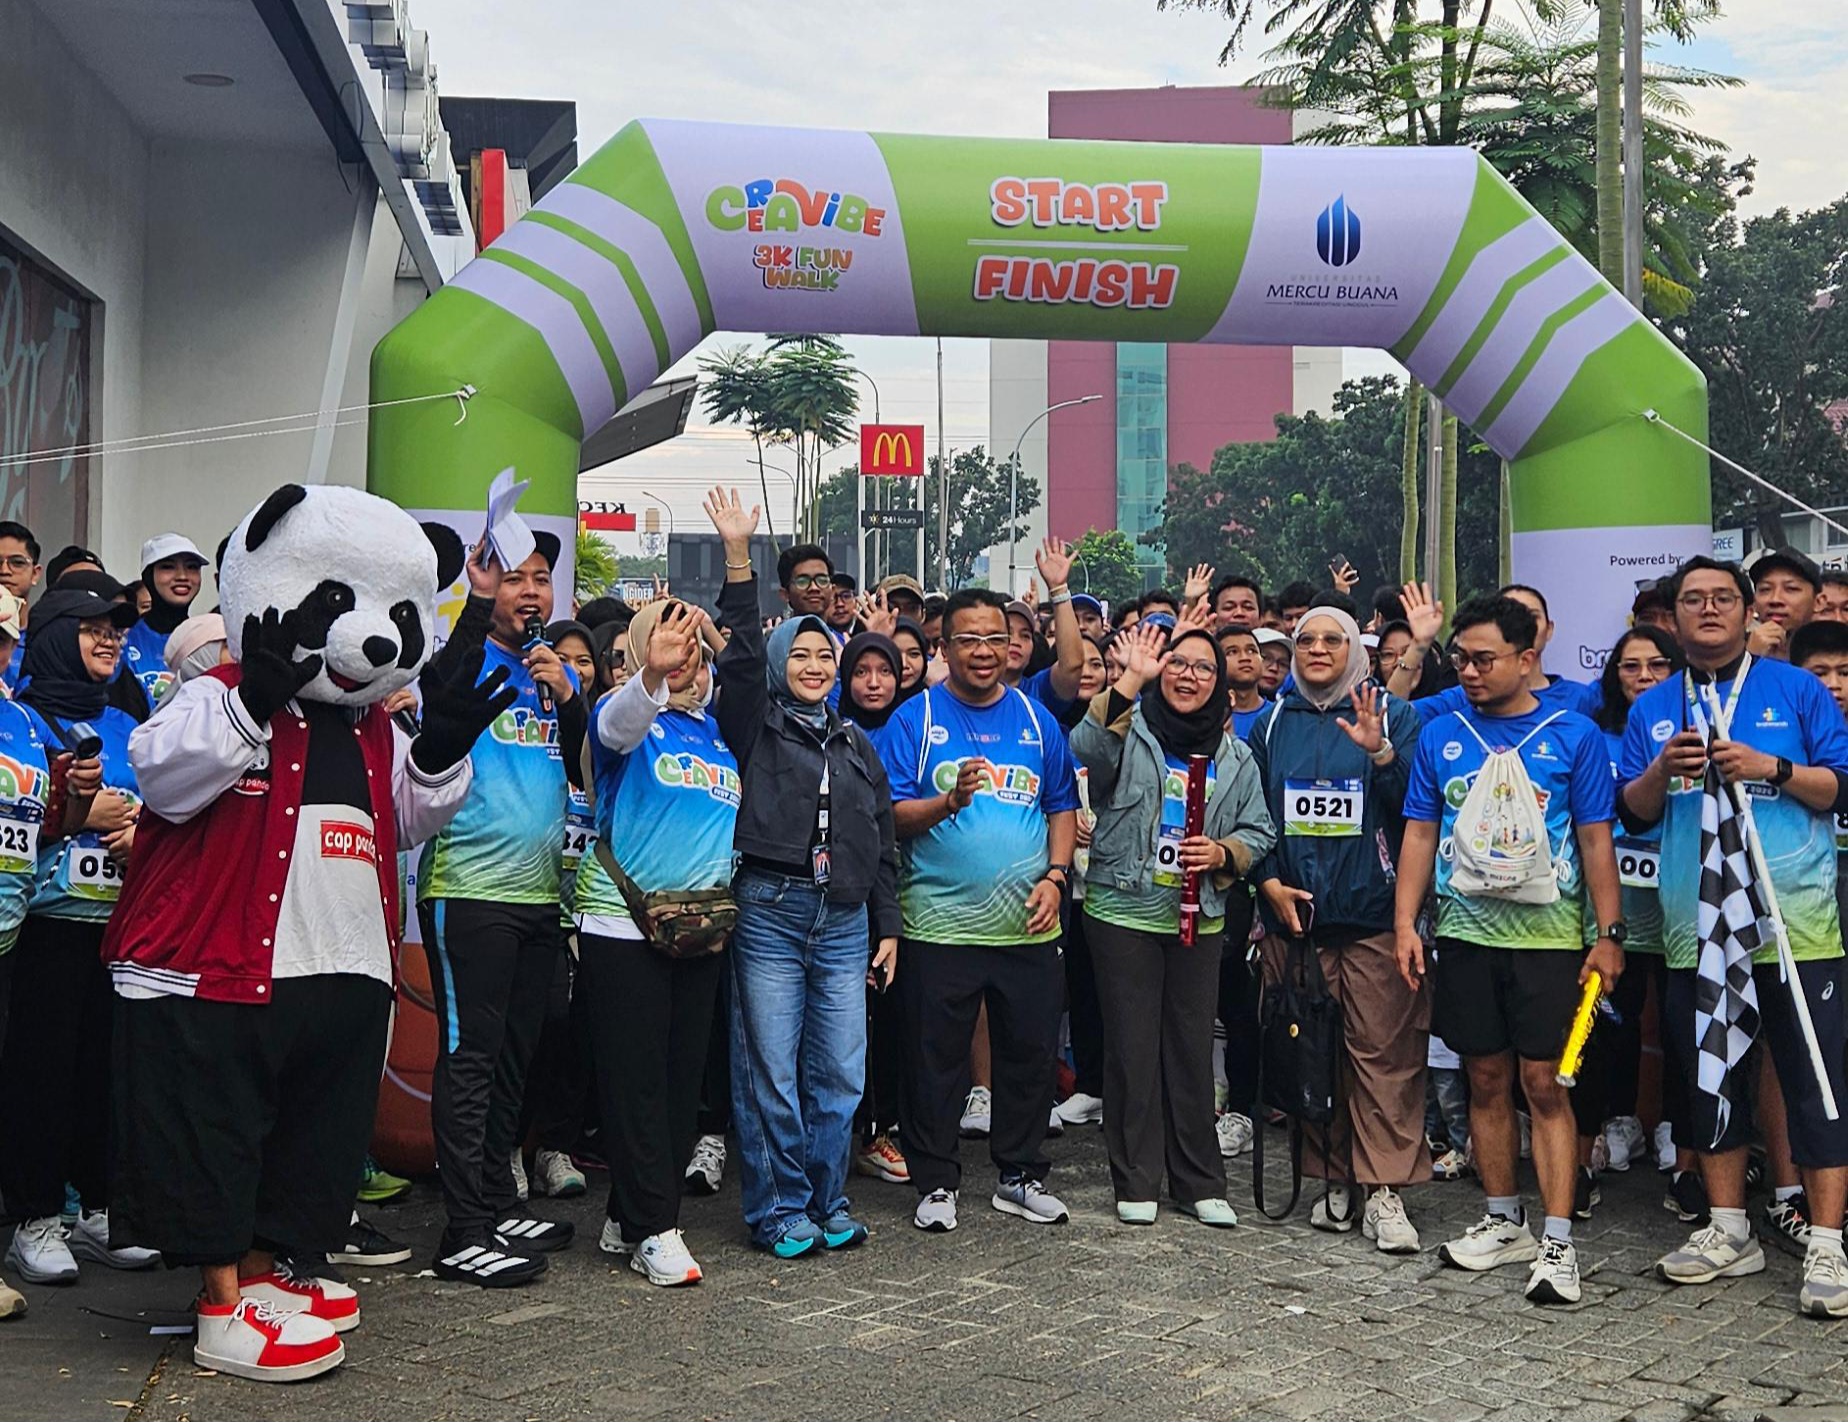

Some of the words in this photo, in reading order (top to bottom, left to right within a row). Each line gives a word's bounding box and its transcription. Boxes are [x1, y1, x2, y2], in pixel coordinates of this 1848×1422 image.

[991, 178, 1167, 229] START
[753, 244, 793, 268] 3K
[796, 245, 854, 272] FUN
[763, 266, 840, 291] WALK
[976, 257, 1178, 308] FINISH
[1266, 284, 1330, 299] MERCU
[1336, 285, 1398, 301] BUANA
[1609, 553, 1665, 566] Powered
[1296, 796, 1353, 818] 0521
[0, 825, 29, 854] 23
[324, 831, 353, 855] cap
[1620, 855, 1661, 879] 00
